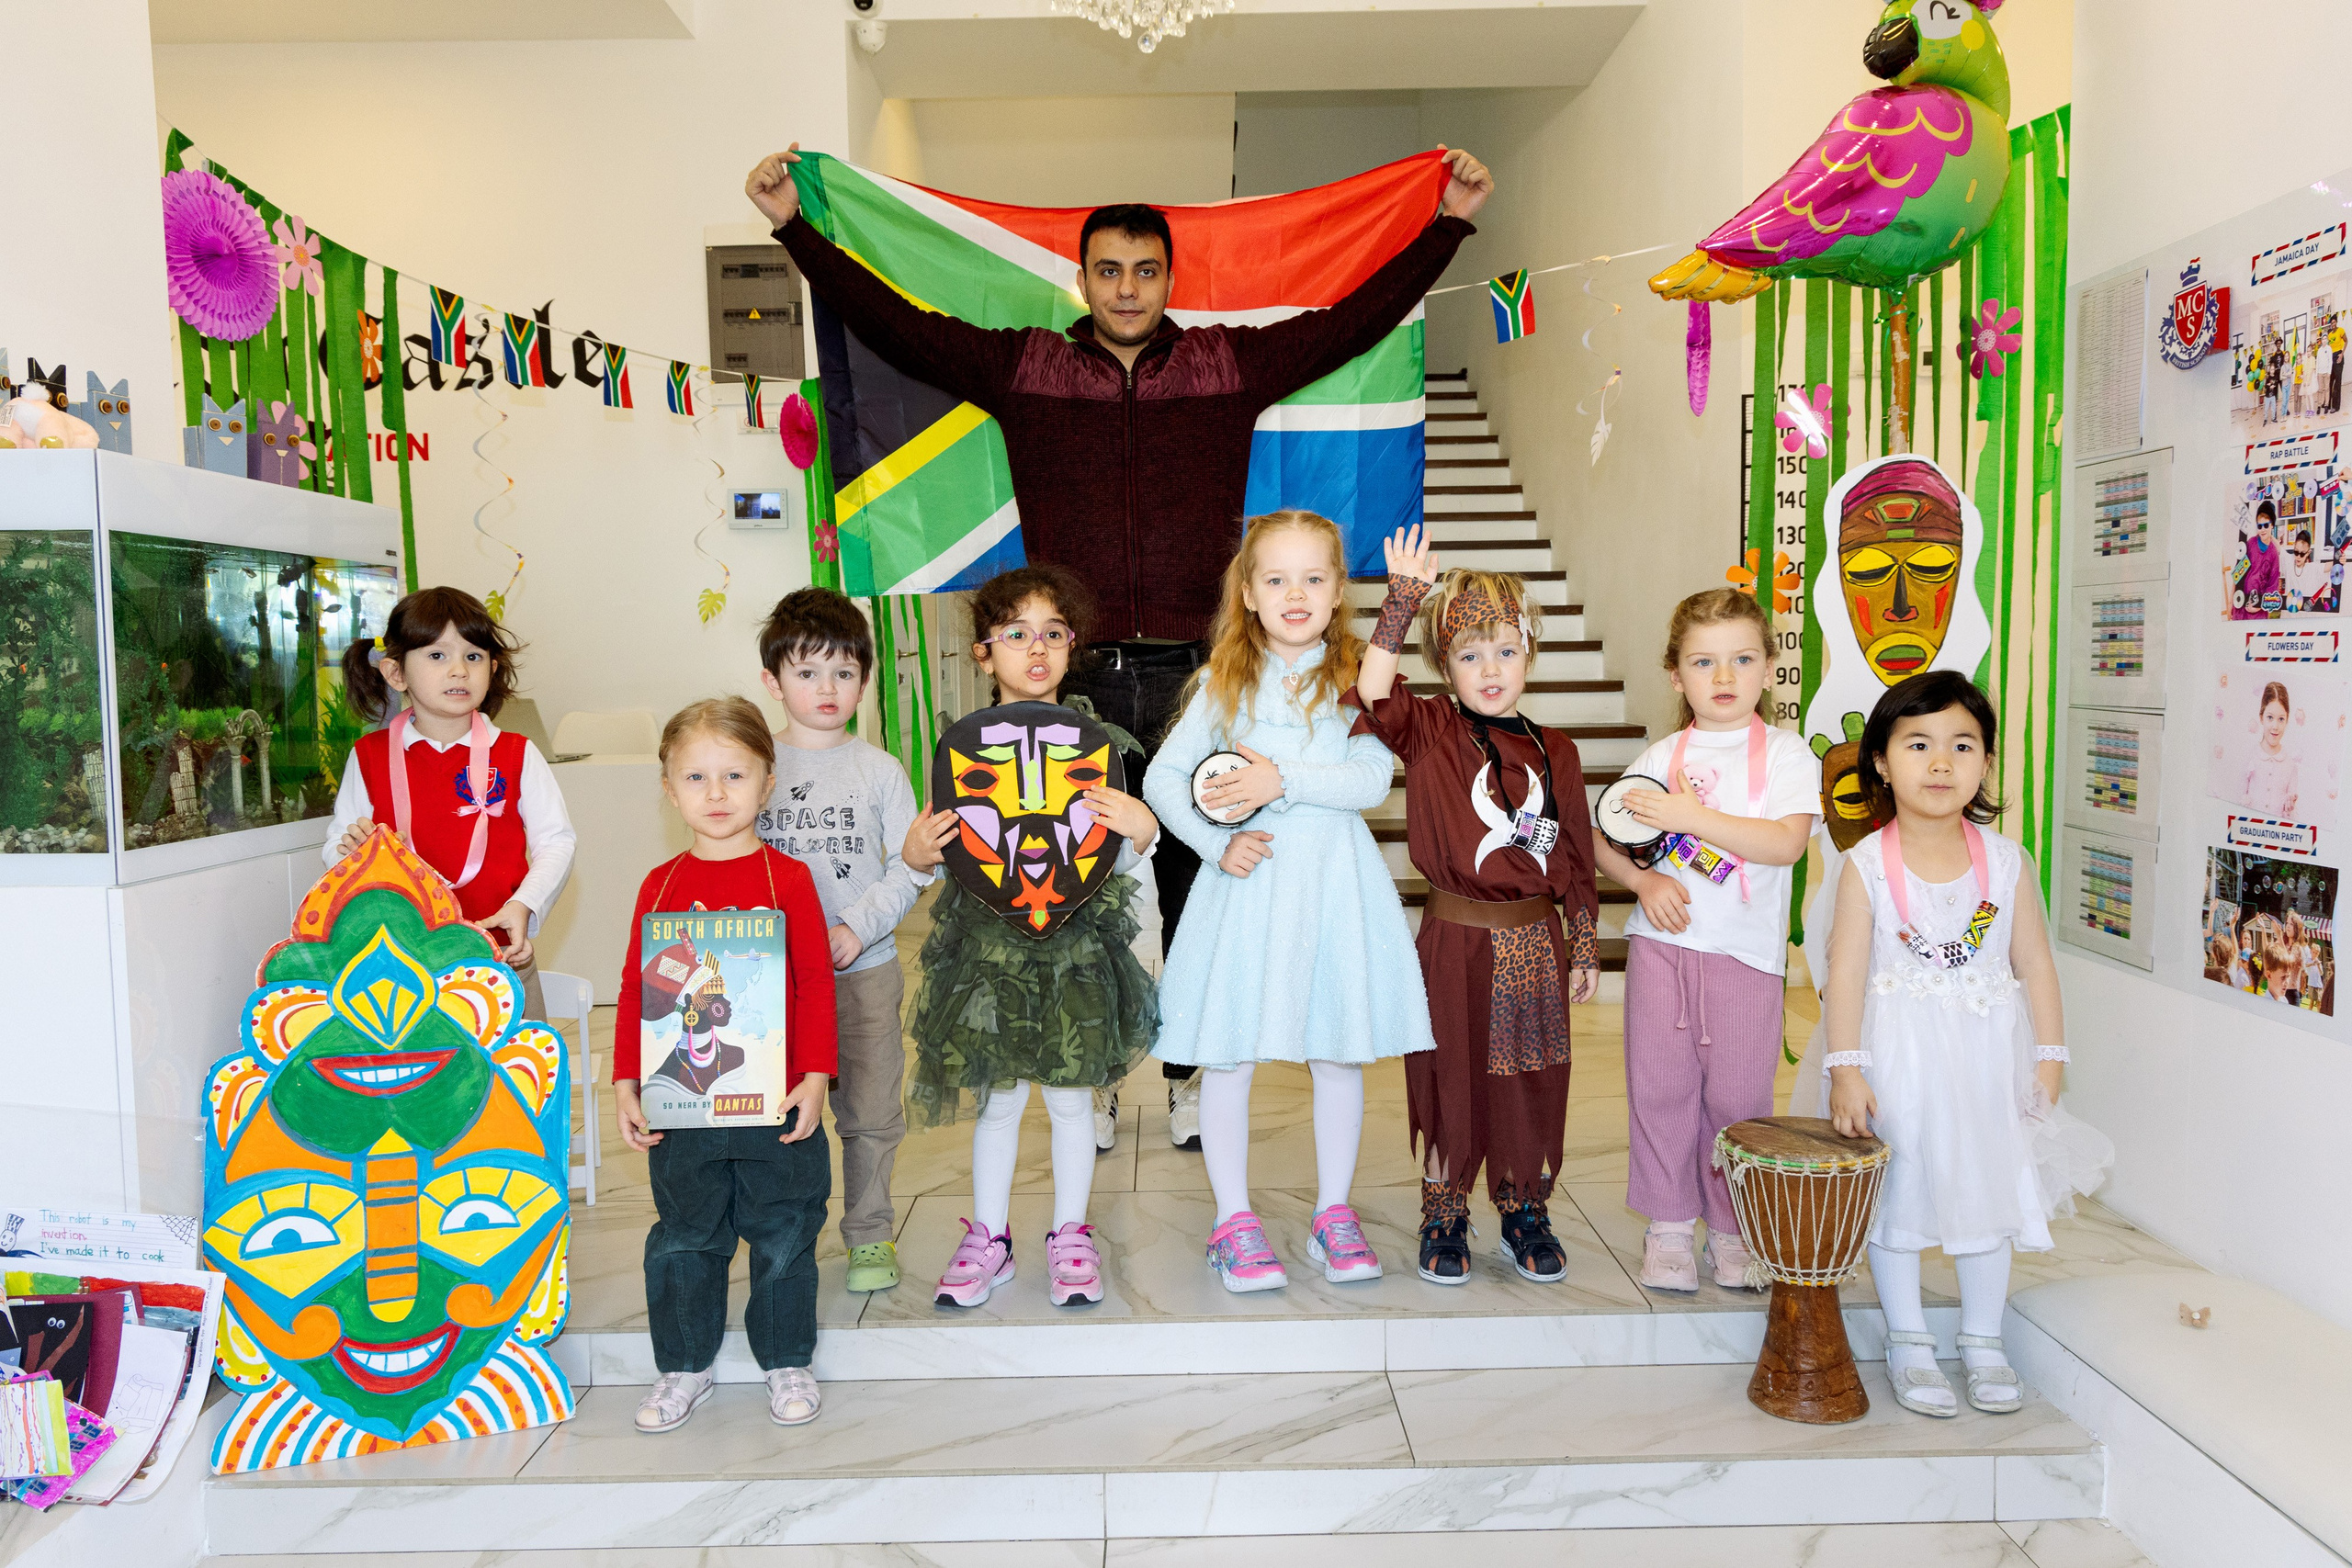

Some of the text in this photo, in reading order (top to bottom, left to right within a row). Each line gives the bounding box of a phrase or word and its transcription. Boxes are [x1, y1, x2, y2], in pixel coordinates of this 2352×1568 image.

[2275, 243, 2319, 266] JAMAICA DAY
[2177, 290, 2203, 320] MC
[2270, 446, 2309, 459] RAP BATTLE
[1777, 457, 1807, 475] 150
[1777, 491, 1806, 509] 140
[1777, 525, 1806, 544] 130
[2267, 641, 2313, 650] FLOWERS DAY
[1776, 667, 1801, 685] 90
[1777, 702, 1800, 720] 80
[757, 807, 855, 831] SPACE
[2240, 827, 2302, 843] GRADUATION PARTY
[652, 919, 774, 941] SOUTH AFRICA
[678, 1101, 696, 1110] NEAR
[715, 1098, 763, 1111] QANTAS
[39, 1209, 136, 1232] This robot is my
[40, 1242, 164, 1262] I've made it to cook
